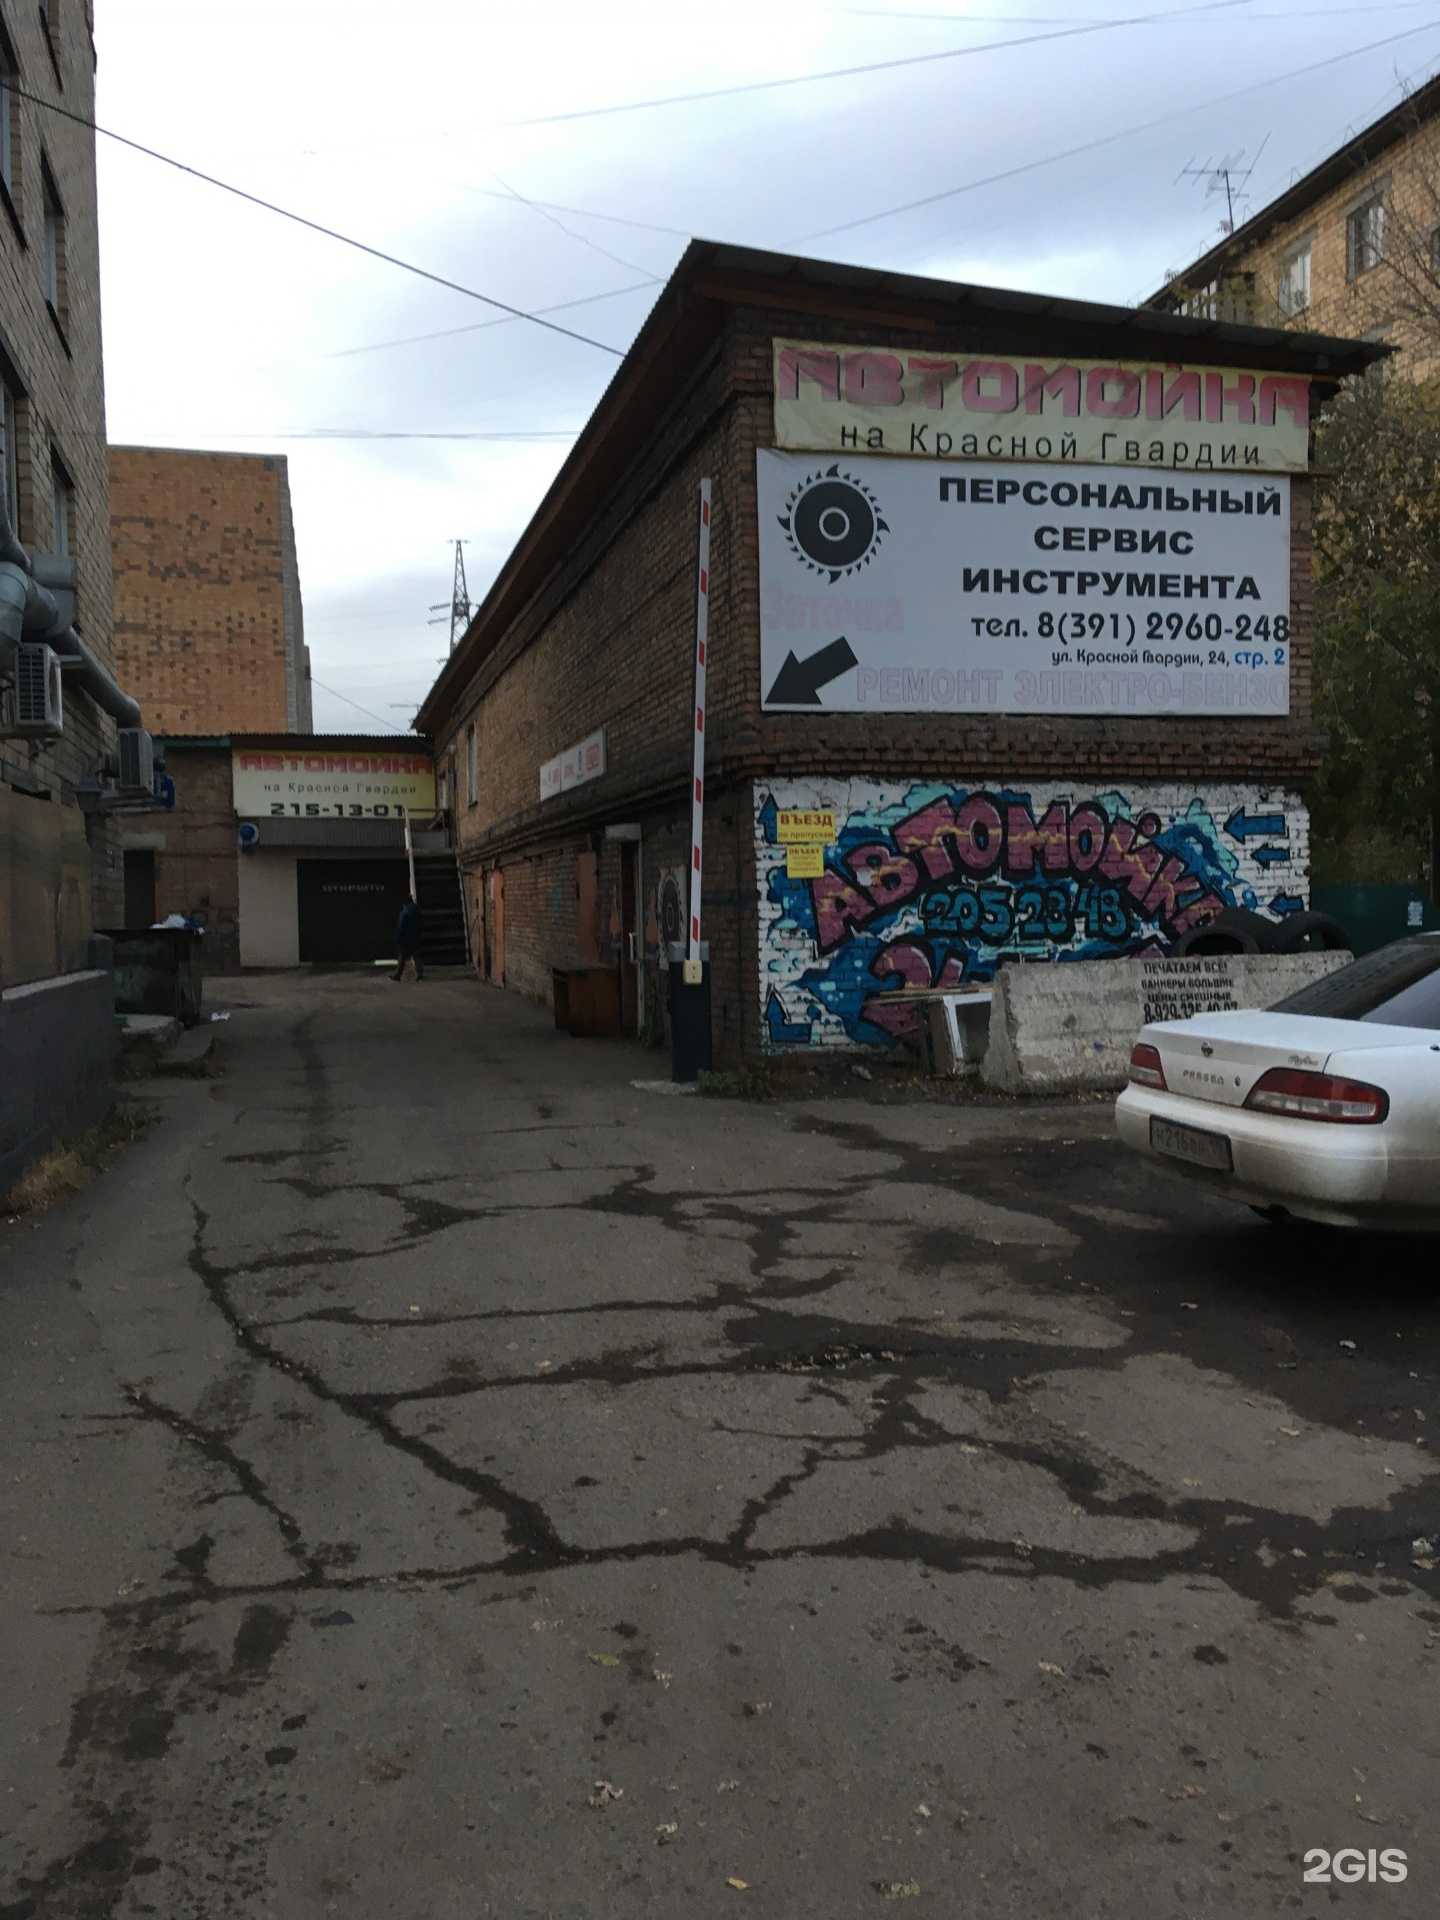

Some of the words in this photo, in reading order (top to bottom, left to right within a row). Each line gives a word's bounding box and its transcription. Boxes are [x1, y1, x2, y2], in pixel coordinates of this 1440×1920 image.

[777, 346, 1311, 427] АВТОМОЙКА
[841, 425, 885, 449] на
[910, 422, 1077, 460] Красной
[1101, 431, 1259, 470] Гвардии
[938, 475, 1283, 517] ПЕРСОНАЛЬНЫЙ
[1033, 524, 1195, 556] СЕРВИС
[961, 566, 1263, 602] ИНСТРУМЕНТА
[970, 614, 1029, 638] тел.
[1036, 610, 1138, 646] 8(391)
[1145, 611, 1290, 643] 2960-248
[1051, 650, 1073, 666] ул.
[1076, 648, 1138, 666] Красной
[1141, 649, 1205, 668] Гвардии,
[1207, 650, 1231, 668] 24,
[1234, 649, 1269, 670] стр.
[1273, 647, 1287, 666] 2
[855, 668, 1003, 706] РЕМОНТ
[263, 781, 281, 793] на
[269, 802, 406, 817] 215-13-01
[780, 813, 833, 827] ВЪЕЗД
[811, 788, 1228, 953] АВТОМОЙКА
[921, 886, 1012, 936] 205
[1141, 980, 1187, 991] БАННЕРЫ
[1144, 961, 1202, 975] ПЕЧАТАЕМ
